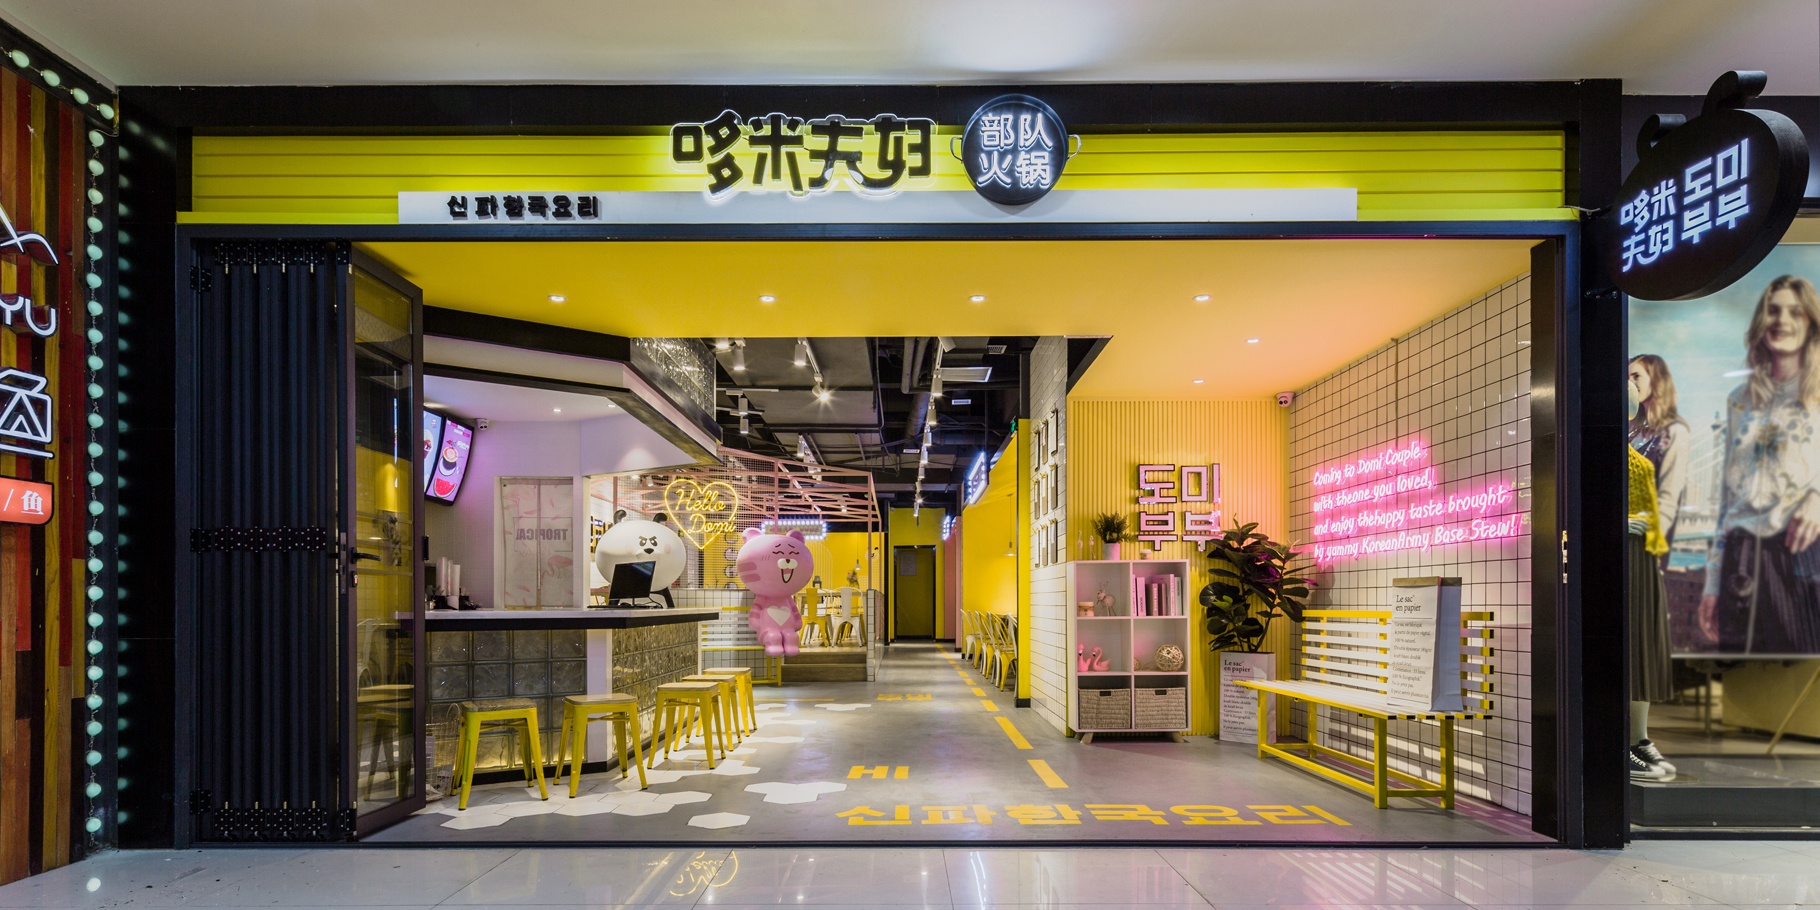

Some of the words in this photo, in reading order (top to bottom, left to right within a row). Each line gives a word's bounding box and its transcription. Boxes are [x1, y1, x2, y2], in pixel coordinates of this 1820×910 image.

[672, 110, 931, 194] 哆米夫妇
[980, 113, 1053, 151] 部队
[977, 150, 1052, 188] 火锅
[1684, 137, 1749, 205] 도미
[1620, 178, 1677, 233] 哆米
[1681, 184, 1749, 245] 부부
[1621, 219, 1675, 273] 夫妇
[1138, 463, 1221, 504] 도미
[1313, 494, 1333, 512] with
[1372, 482, 1392, 502] you
[1396, 468, 1432, 492] loved,
[1314, 467, 1342, 486] Coming
[1344, 464, 1355, 478] to
[1357, 453, 1382, 474] Domi
[675, 488, 726, 513] Hello
[1313, 518, 1329, 535] and
[1330, 516, 1355, 536] enjoy
[1408, 499, 1444, 520] taste
[1447, 485, 1508, 514] brought
[687, 513, 737, 534] Domi
[1137, 510, 1225, 552] 부부
[1313, 544, 1324, 562] by
[1434, 525, 1464, 544] Base
[1469, 514, 1516, 540] Stew!
[1404, 604, 1421, 613] papier
[846, 765, 910, 780] HI
[835, 803, 1353, 826] 신파한국요리
